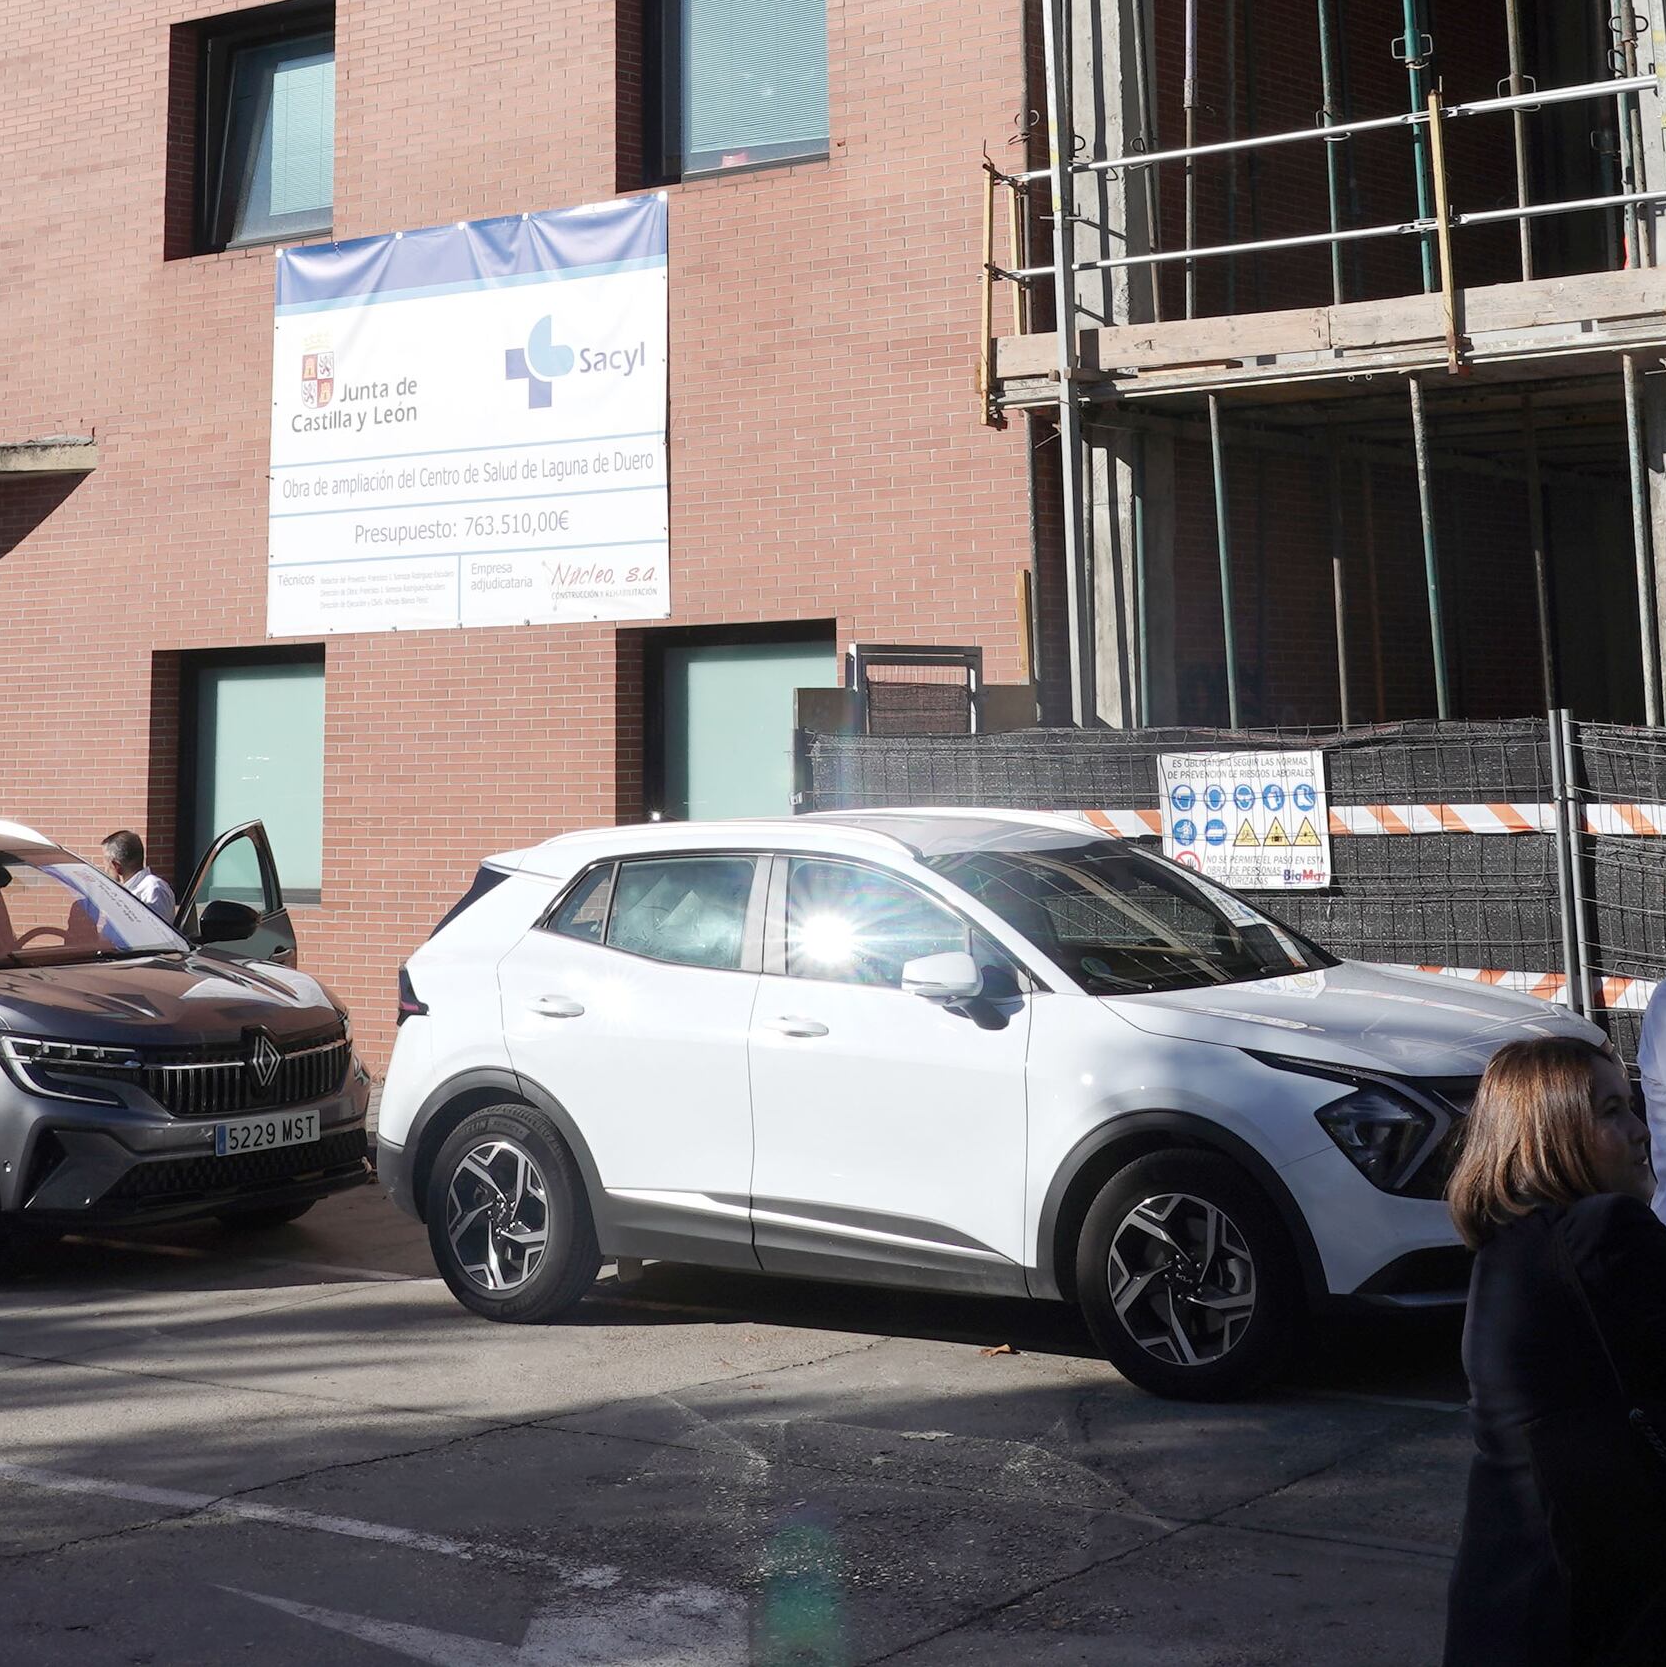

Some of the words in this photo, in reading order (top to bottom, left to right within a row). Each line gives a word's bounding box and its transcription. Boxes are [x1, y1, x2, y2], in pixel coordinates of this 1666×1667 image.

[580, 341, 646, 378] Sacyl
[340, 380, 388, 403] Junta
[396, 377, 418, 397] de
[291, 410, 352, 433] Castilla
[356, 413, 367, 433] y
[374, 401, 418, 425] León
[282, 479, 310, 499] Obra
[313, 477, 328, 496] de
[331, 471, 393, 498] ampliación
[398, 469, 416, 489] del
[420, 467, 460, 488] Centro
[464, 463, 480, 484] de
[483, 461, 518, 483] Salud
[521, 458, 538, 480] de
[541, 457, 589, 483] Laguna
[593, 452, 610, 474] de
[613, 451, 654, 472] Duero
[355, 518, 457, 546] Presupuesto:
[464, 509, 570, 538] 763.510,00€
[471, 562, 513, 576] Empresa
[278, 574, 315, 587] Técnicos
[470, 576, 533, 592] adjudicataria
[1172, 758, 1183, 768] ES
[1233, 757, 1258, 767] SEGUIR
[1261, 757, 1275, 767] LAS
[1276, 757, 1308, 766] NORMAS
[1167, 770, 1178, 780] DE
[1228, 769, 1238, 778] DE
[1271, 767, 1315, 778] LABORALES
[1273, 855, 1293, 864] PASO
[1295, 855, 1306, 864] EN
[228, 1122, 276, 1150] 5229
[282, 1116, 316, 1142] MST
